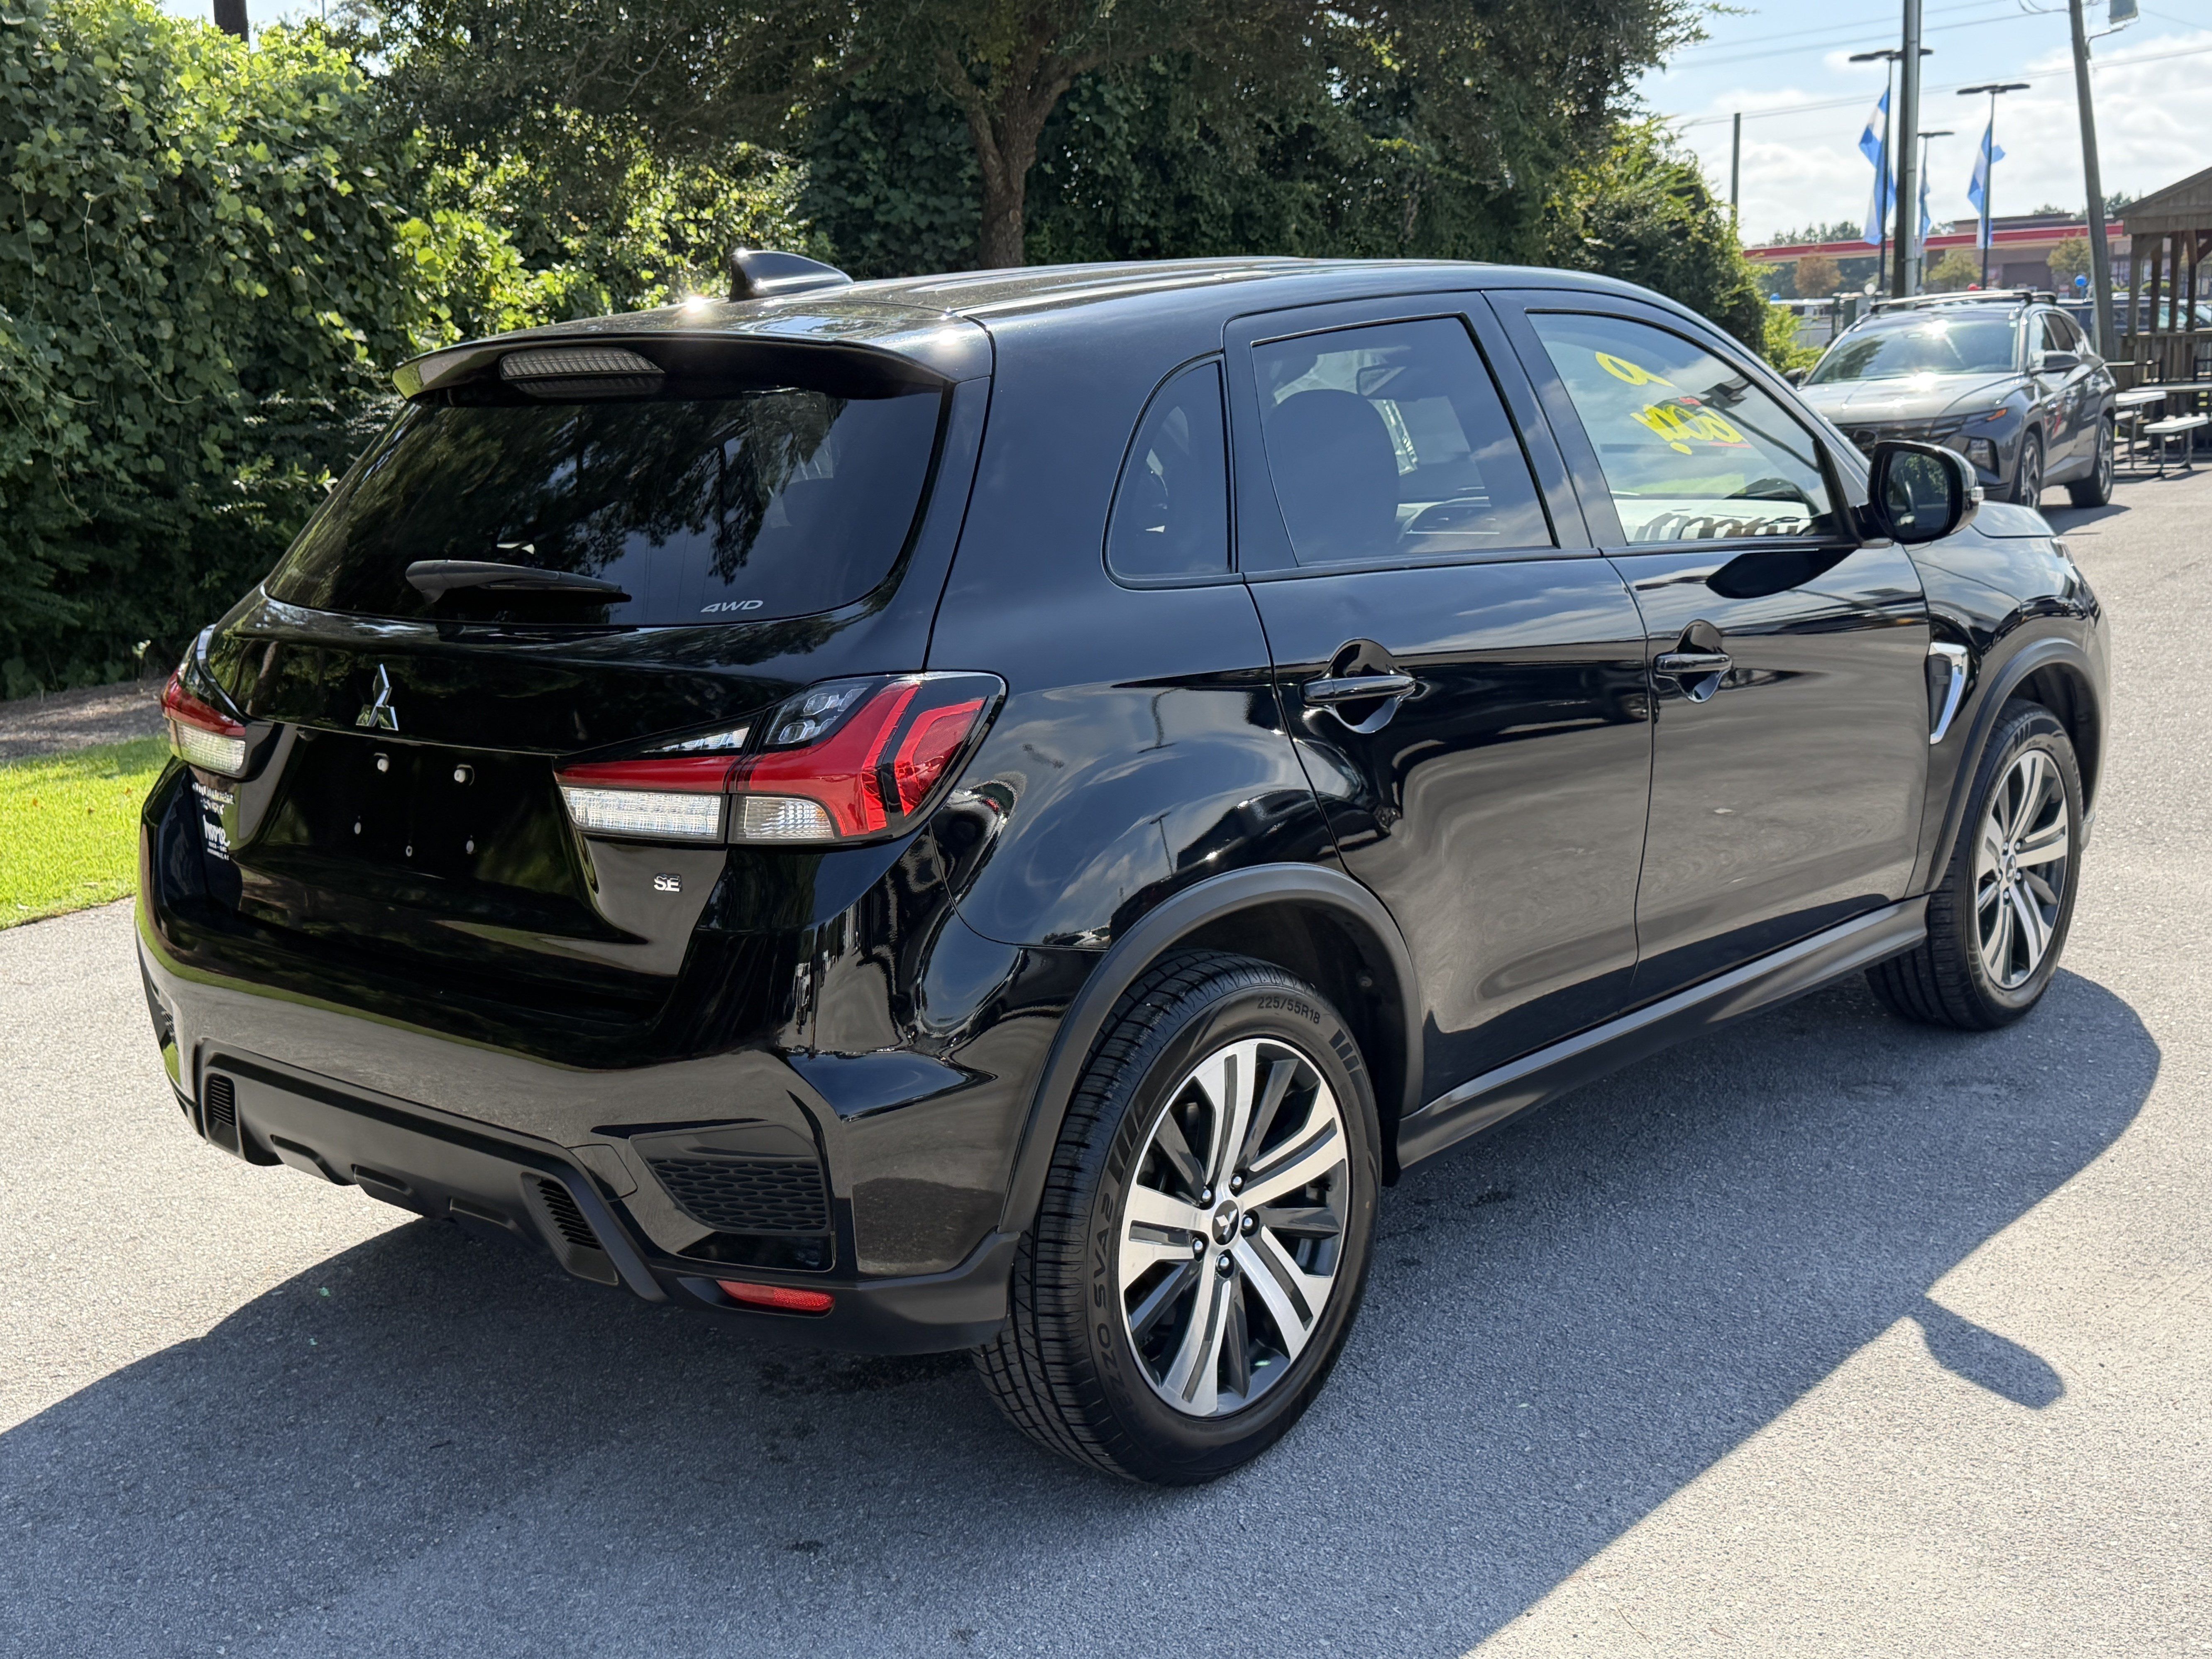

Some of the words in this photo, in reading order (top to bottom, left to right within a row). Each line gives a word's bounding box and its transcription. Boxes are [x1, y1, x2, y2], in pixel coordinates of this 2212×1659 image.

[700, 600, 763, 613] 4WD
[653, 874, 681, 892] SE
[1257, 996, 1321, 1025] 225/55R18
